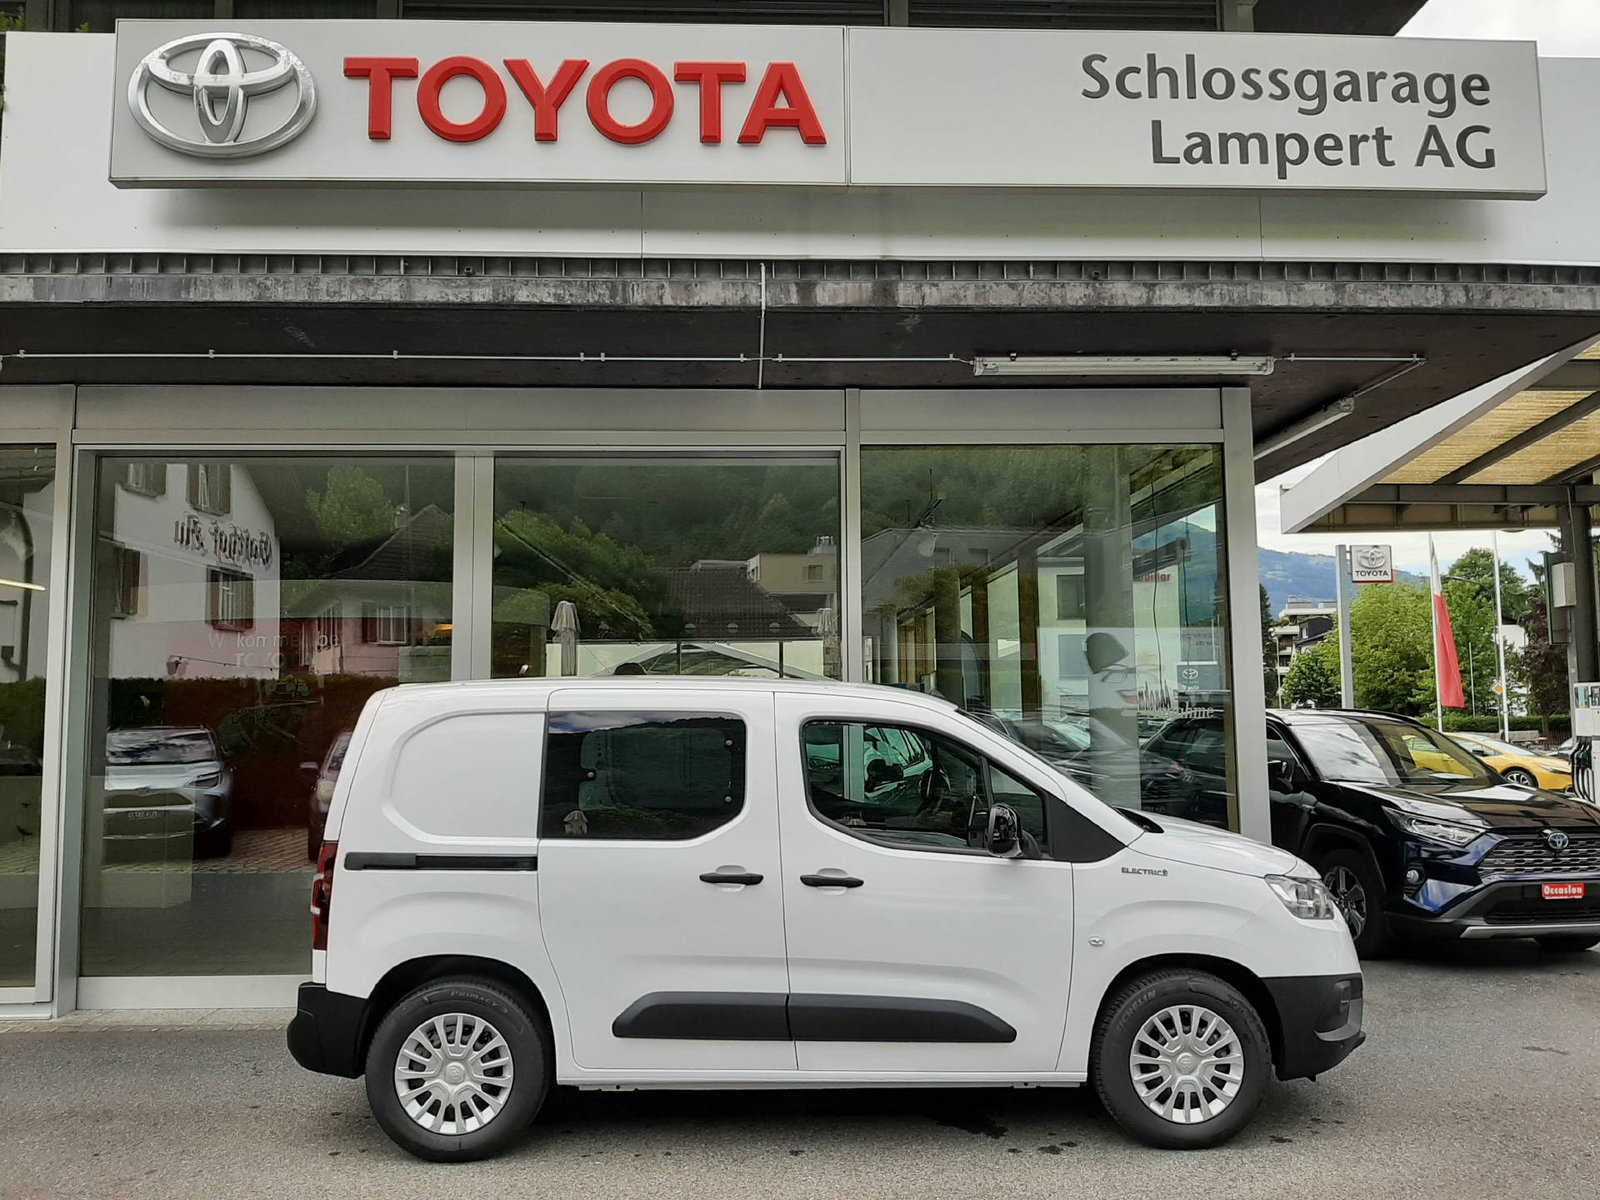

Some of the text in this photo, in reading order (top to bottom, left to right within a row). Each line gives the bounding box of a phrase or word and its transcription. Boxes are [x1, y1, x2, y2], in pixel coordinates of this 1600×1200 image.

[343, 55, 827, 146] TOYOTA
[1081, 53, 1491, 119] Schlossgarage
[1151, 119, 1495, 180] Lampert AG
[1121, 867, 1163, 877] ELECTRIC
